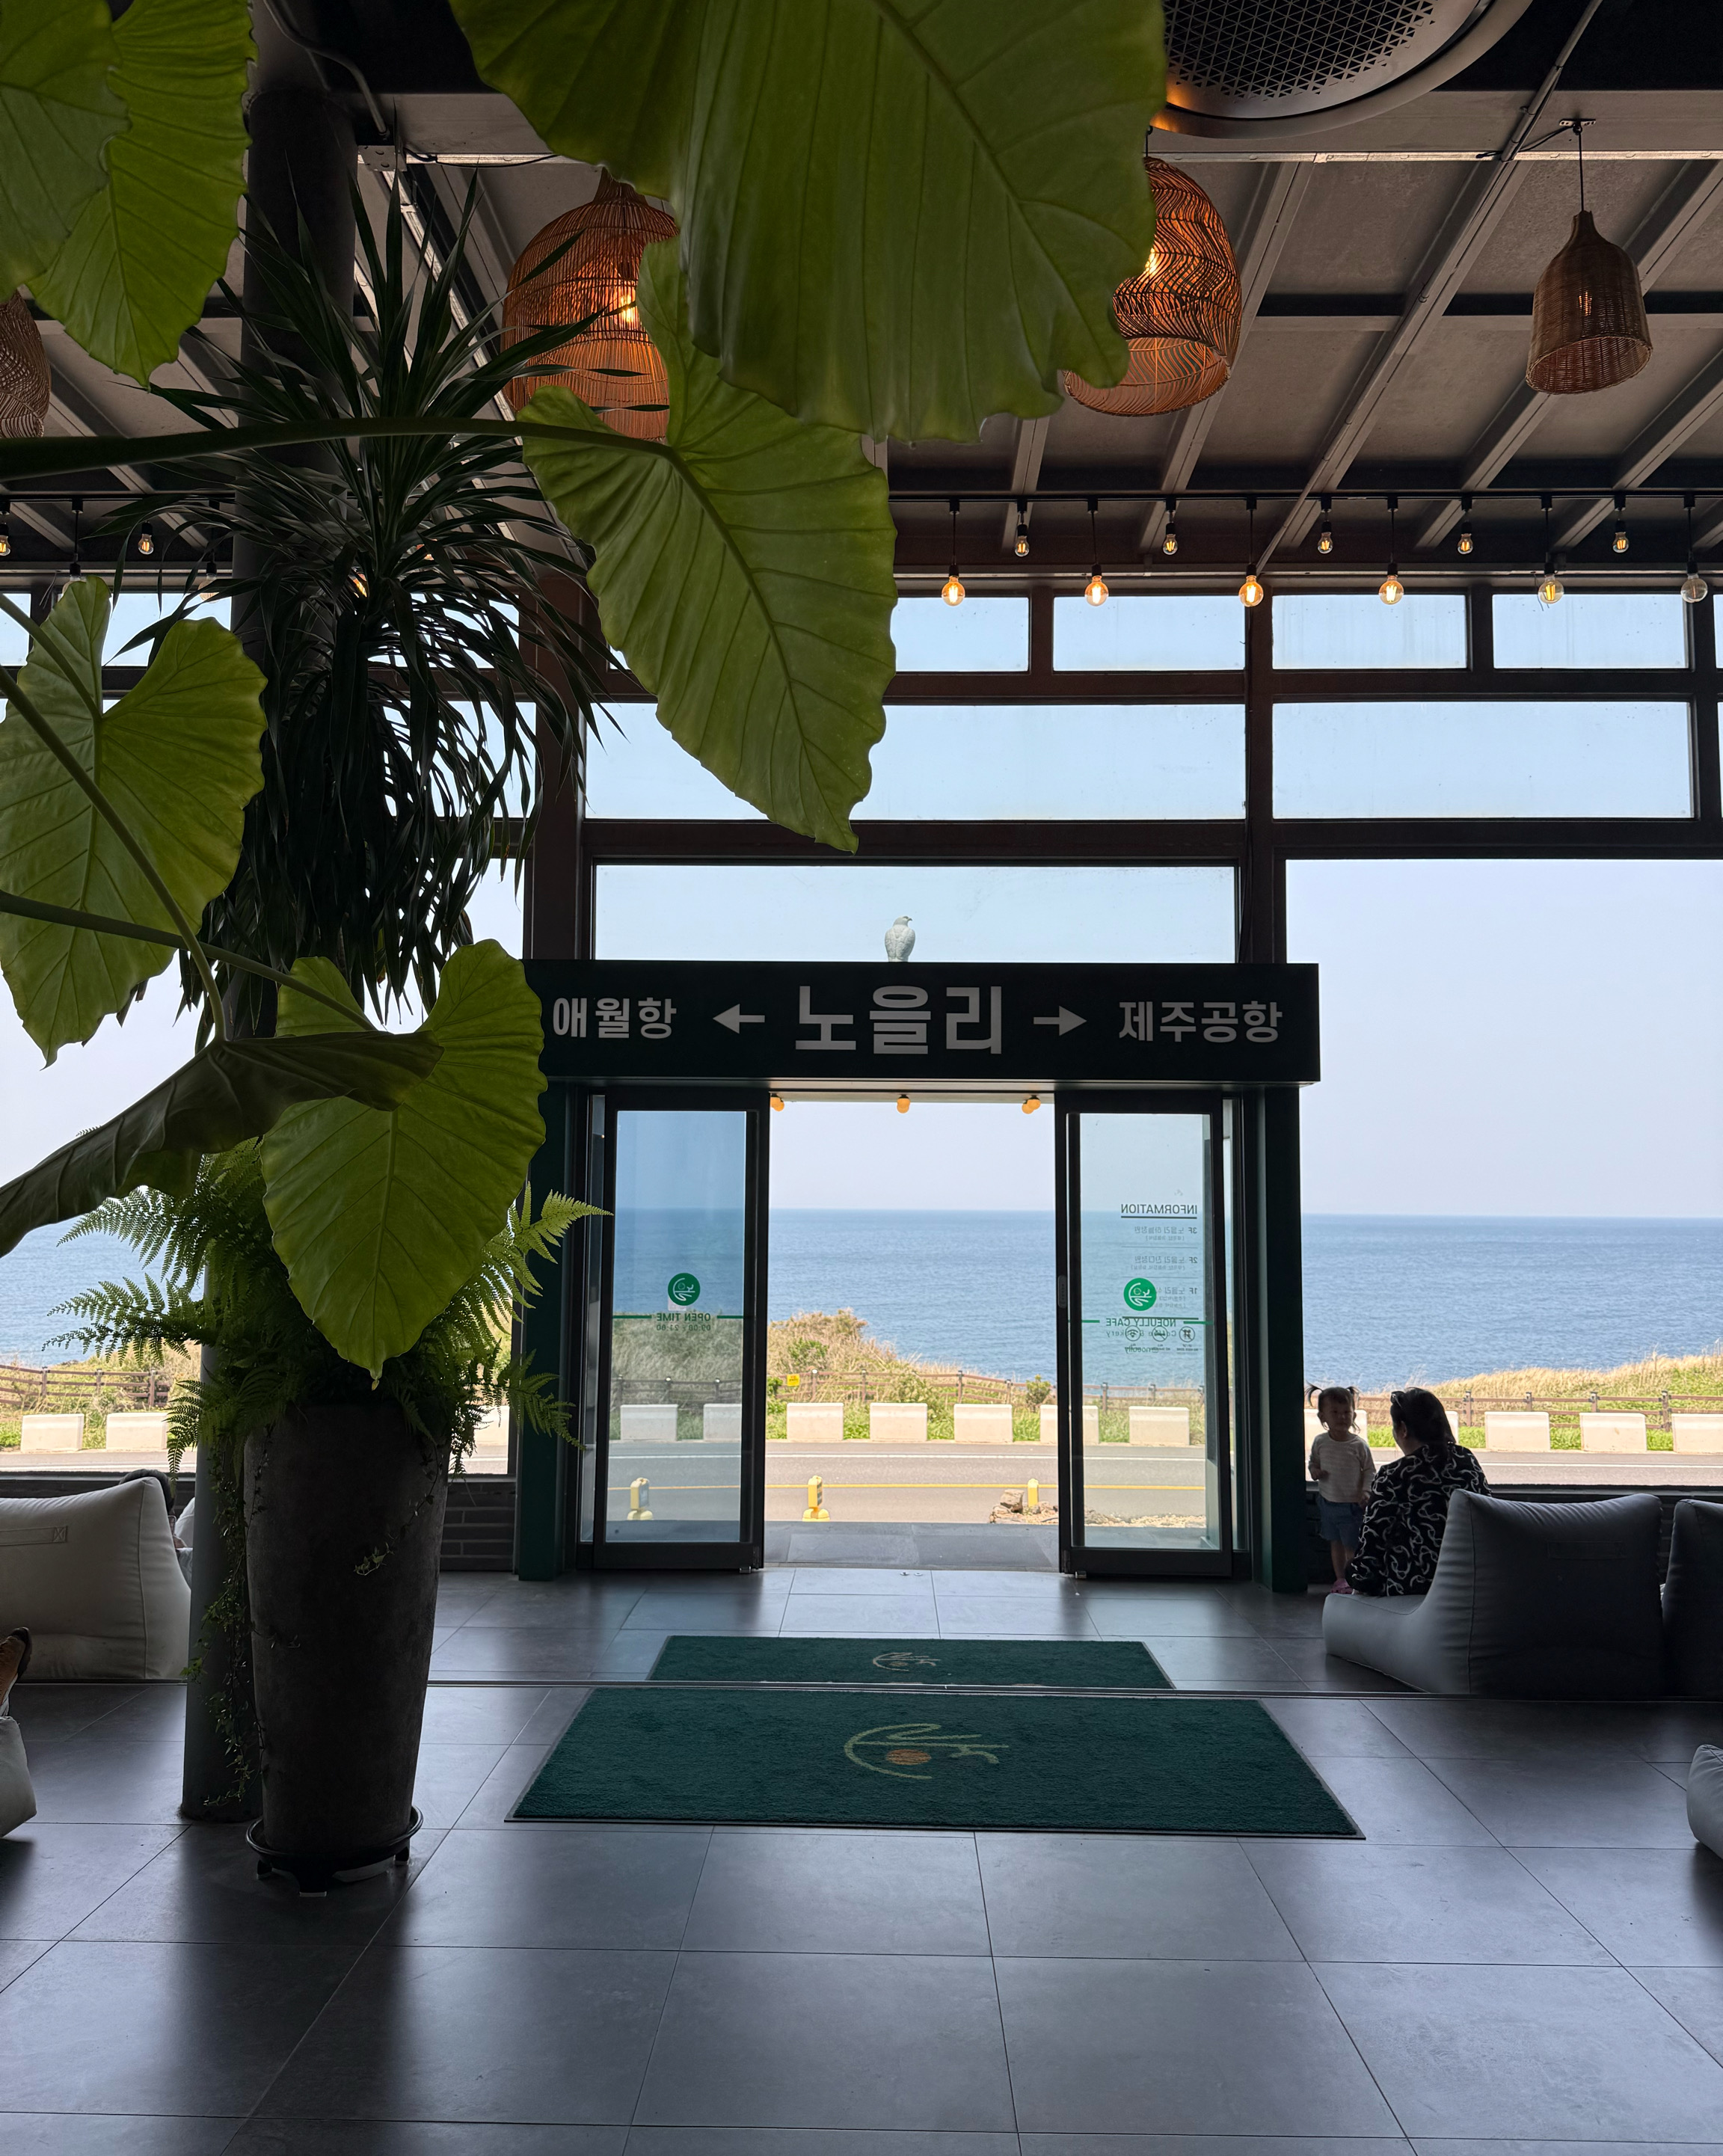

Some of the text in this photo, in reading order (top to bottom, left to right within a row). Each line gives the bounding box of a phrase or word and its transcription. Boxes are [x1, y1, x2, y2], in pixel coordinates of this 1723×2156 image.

[553, 997, 677, 1039] 애월항
[795, 986, 1002, 1055] 노을리
[1119, 1001, 1283, 1043] 제주공항
